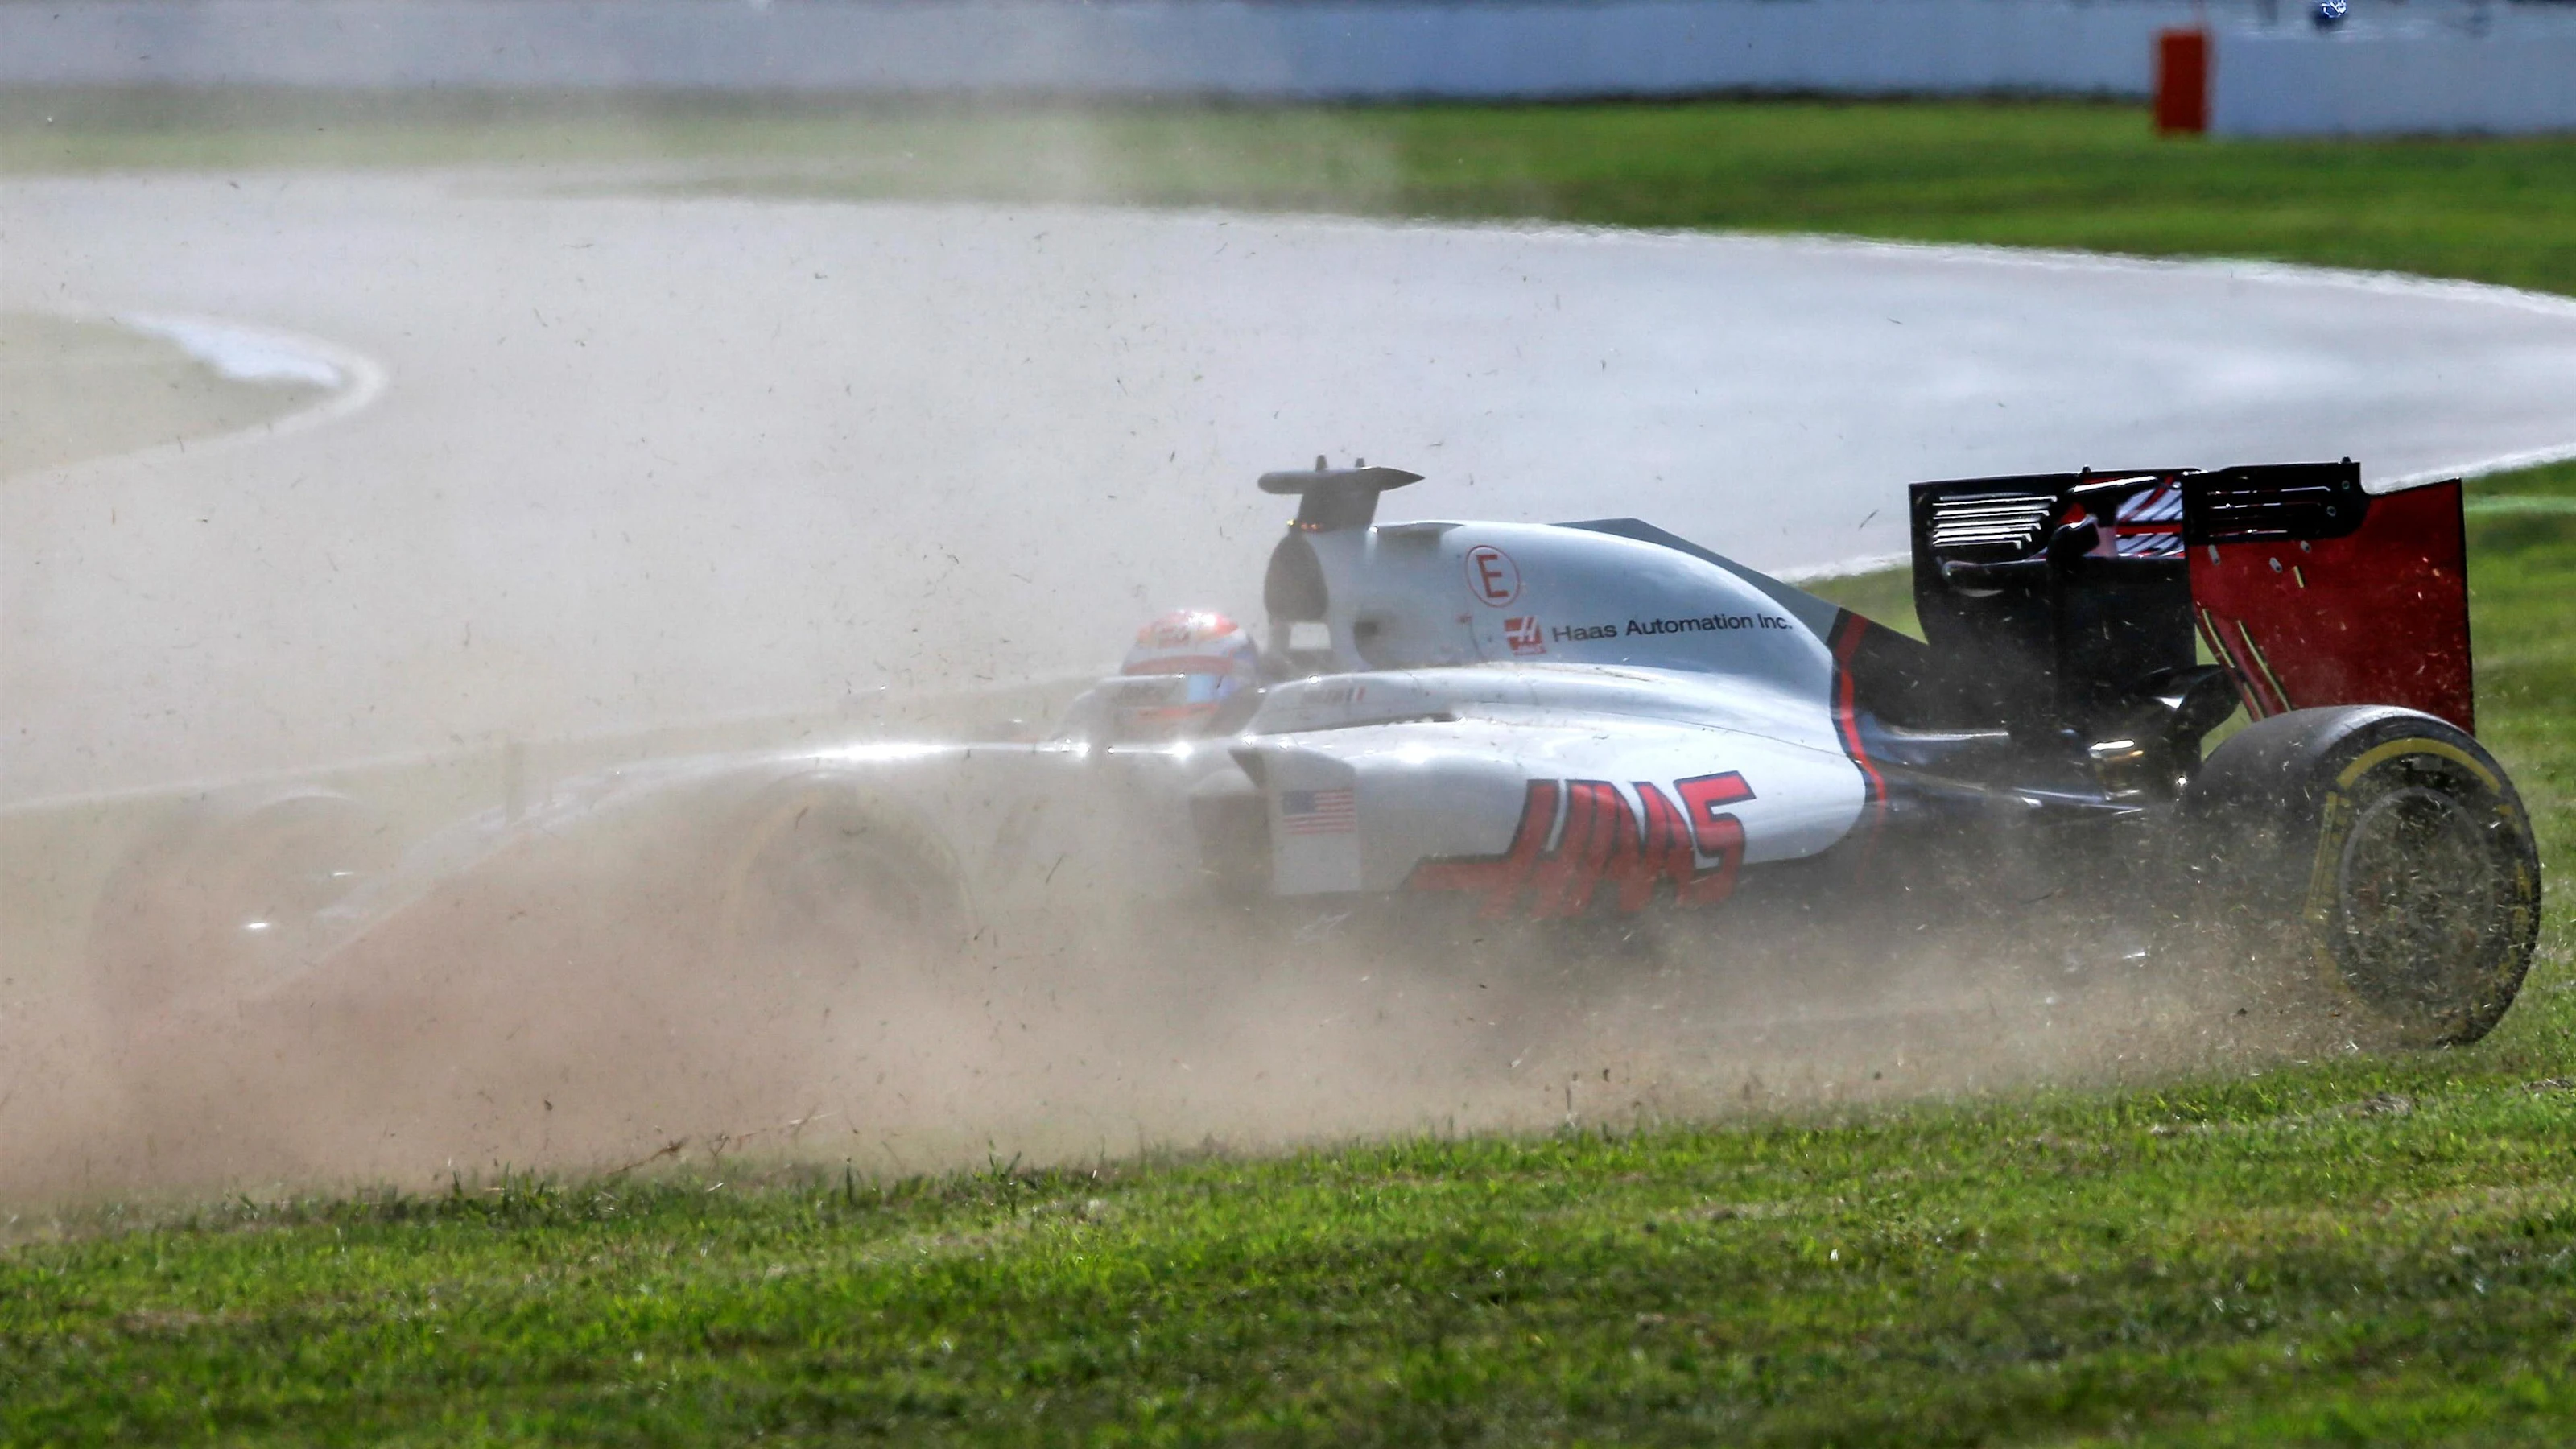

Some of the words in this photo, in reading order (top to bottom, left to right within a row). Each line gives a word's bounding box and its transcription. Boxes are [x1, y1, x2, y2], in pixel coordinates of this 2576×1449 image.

[1476, 554, 1509, 598] E
[1553, 623, 1618, 642] Haas
[1625, 614, 1754, 636] Automation
[1759, 613, 1793, 630] Inc.
[1402, 770, 1757, 919] HAAS
